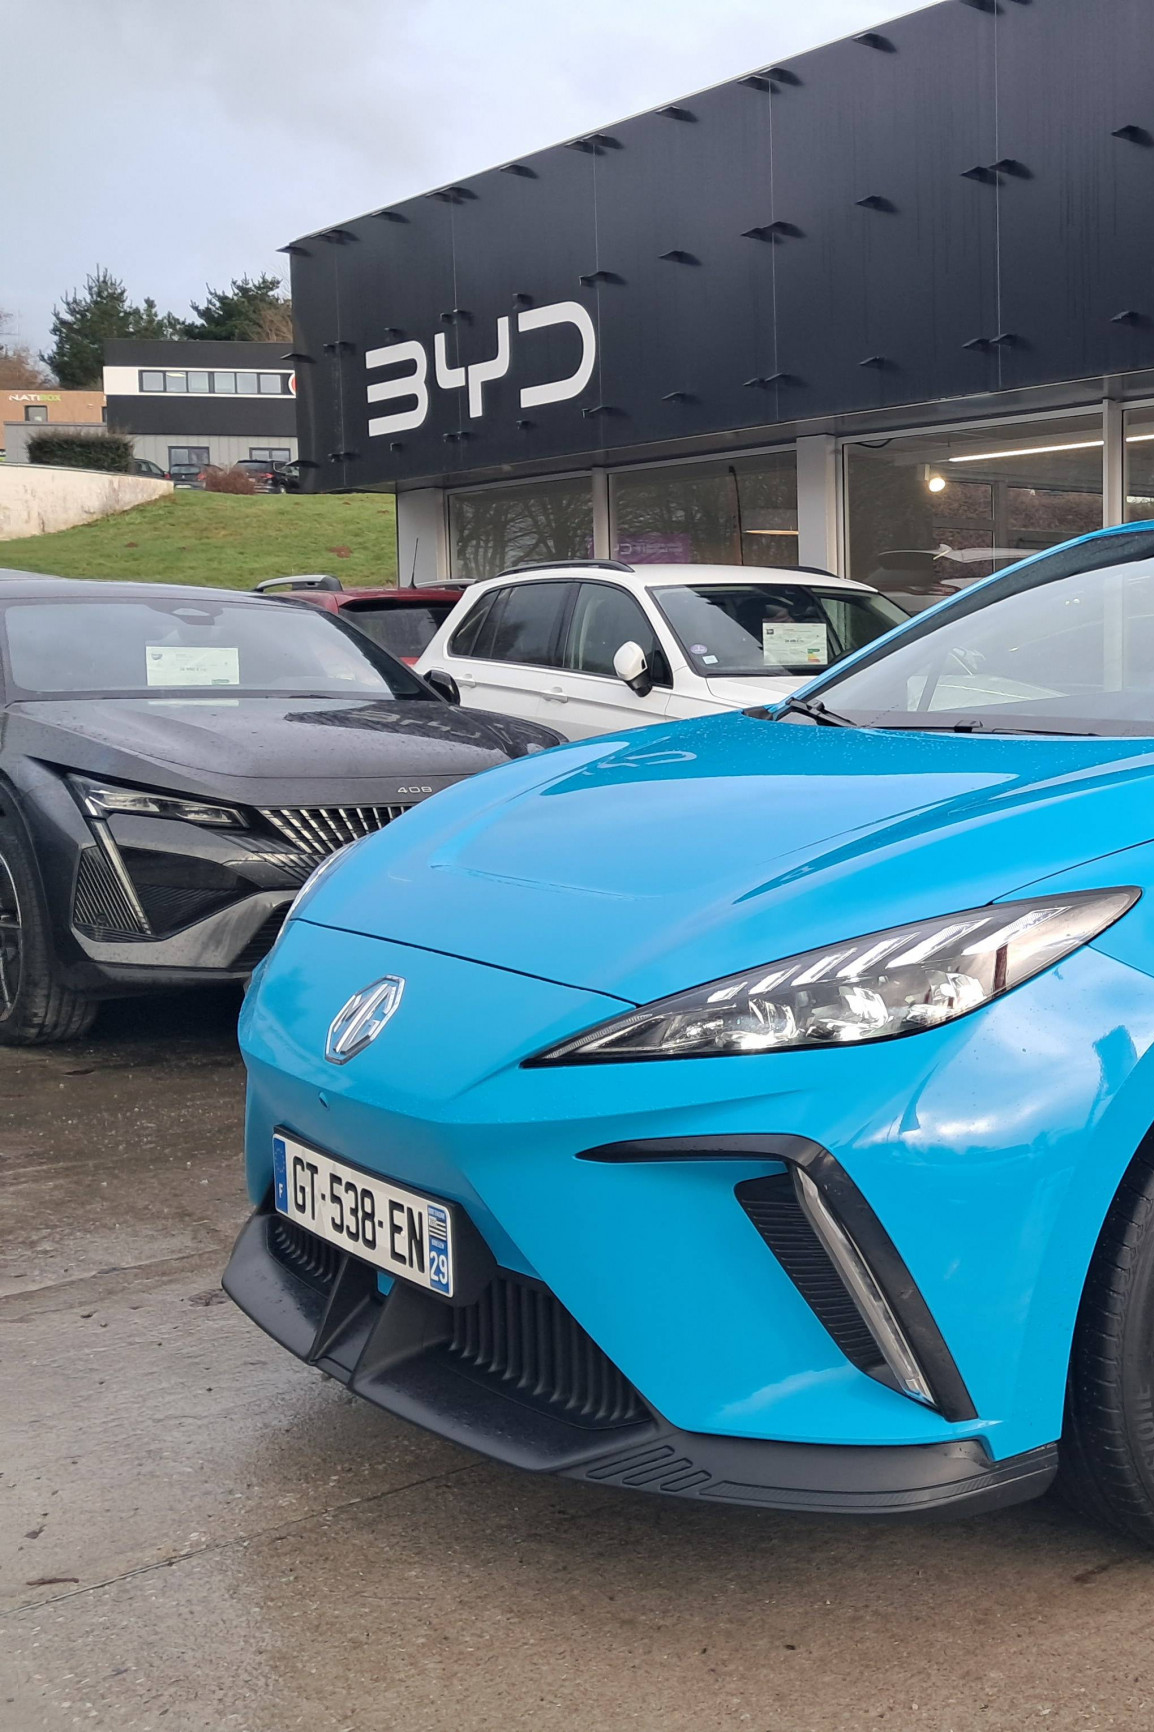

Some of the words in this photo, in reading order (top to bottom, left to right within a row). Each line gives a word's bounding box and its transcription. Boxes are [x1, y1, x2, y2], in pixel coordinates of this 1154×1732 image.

[366, 301, 596, 437] BYD
[397, 786, 433, 794] 408
[331, 980, 399, 1057] MG
[278, 1182, 284, 1198] F
[293, 1155, 425, 1274] GT-538-EN
[430, 1250, 448, 1285] 29
